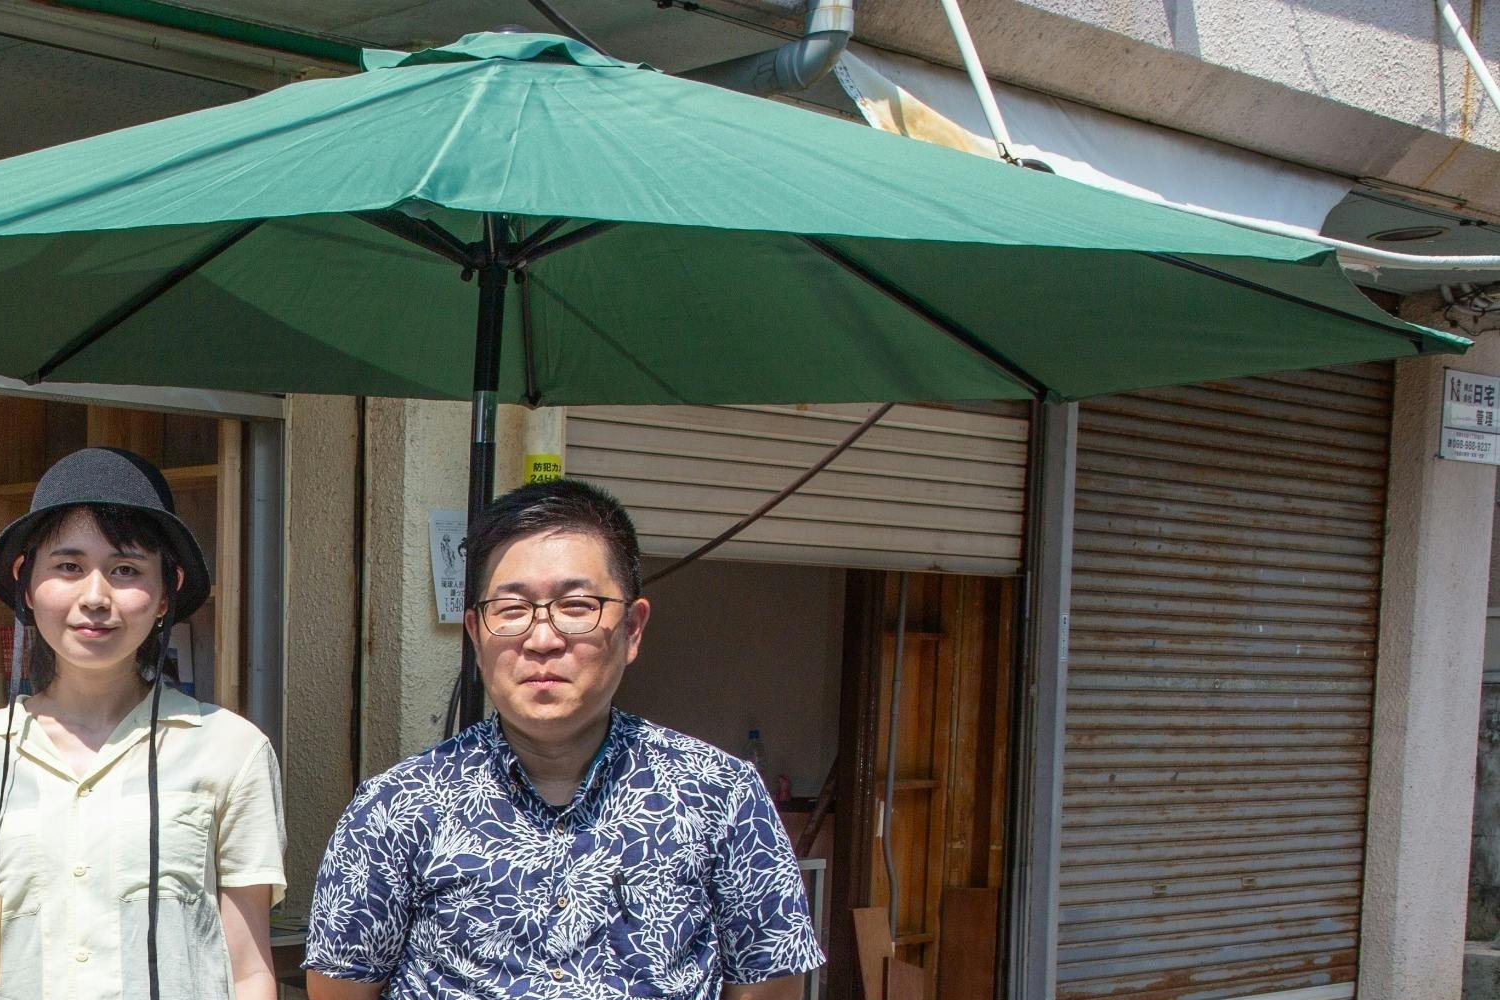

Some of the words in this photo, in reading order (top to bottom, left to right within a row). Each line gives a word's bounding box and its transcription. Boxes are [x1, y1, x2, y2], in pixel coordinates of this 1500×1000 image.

[1474, 384, 1495, 408] 日宅
[532, 462, 562, 472] 防犯カ
